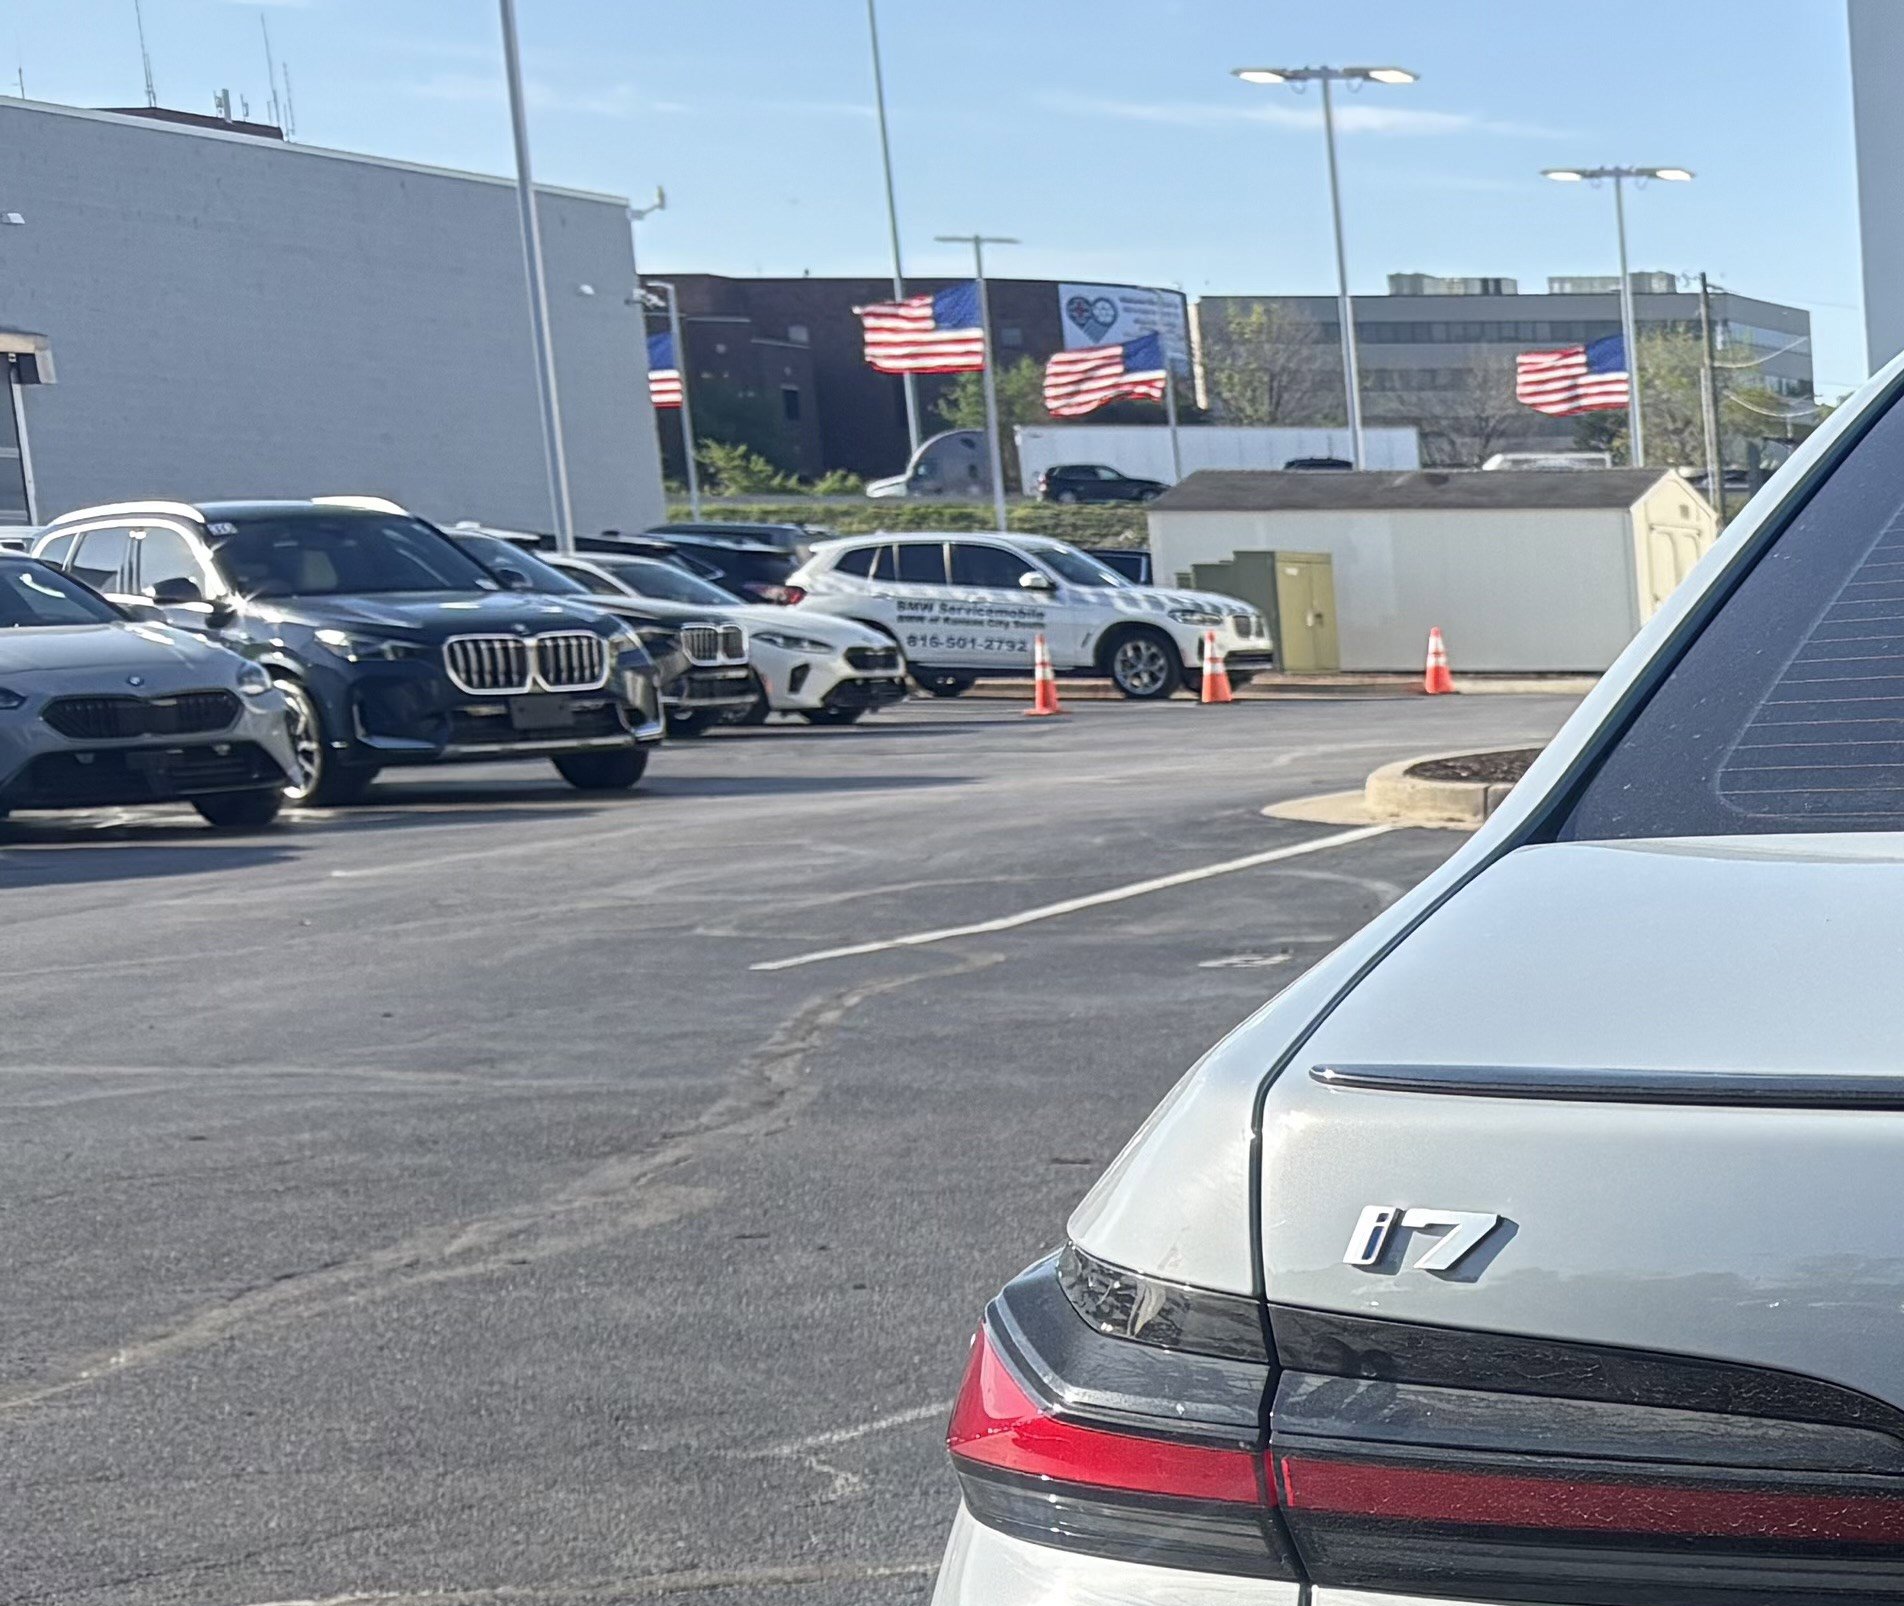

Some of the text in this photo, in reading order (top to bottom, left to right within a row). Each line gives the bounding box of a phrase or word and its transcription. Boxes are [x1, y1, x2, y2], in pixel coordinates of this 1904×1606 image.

[897, 600, 1045, 619] BMW Servicemobile
[1343, 1205, 1499, 1271] i7
